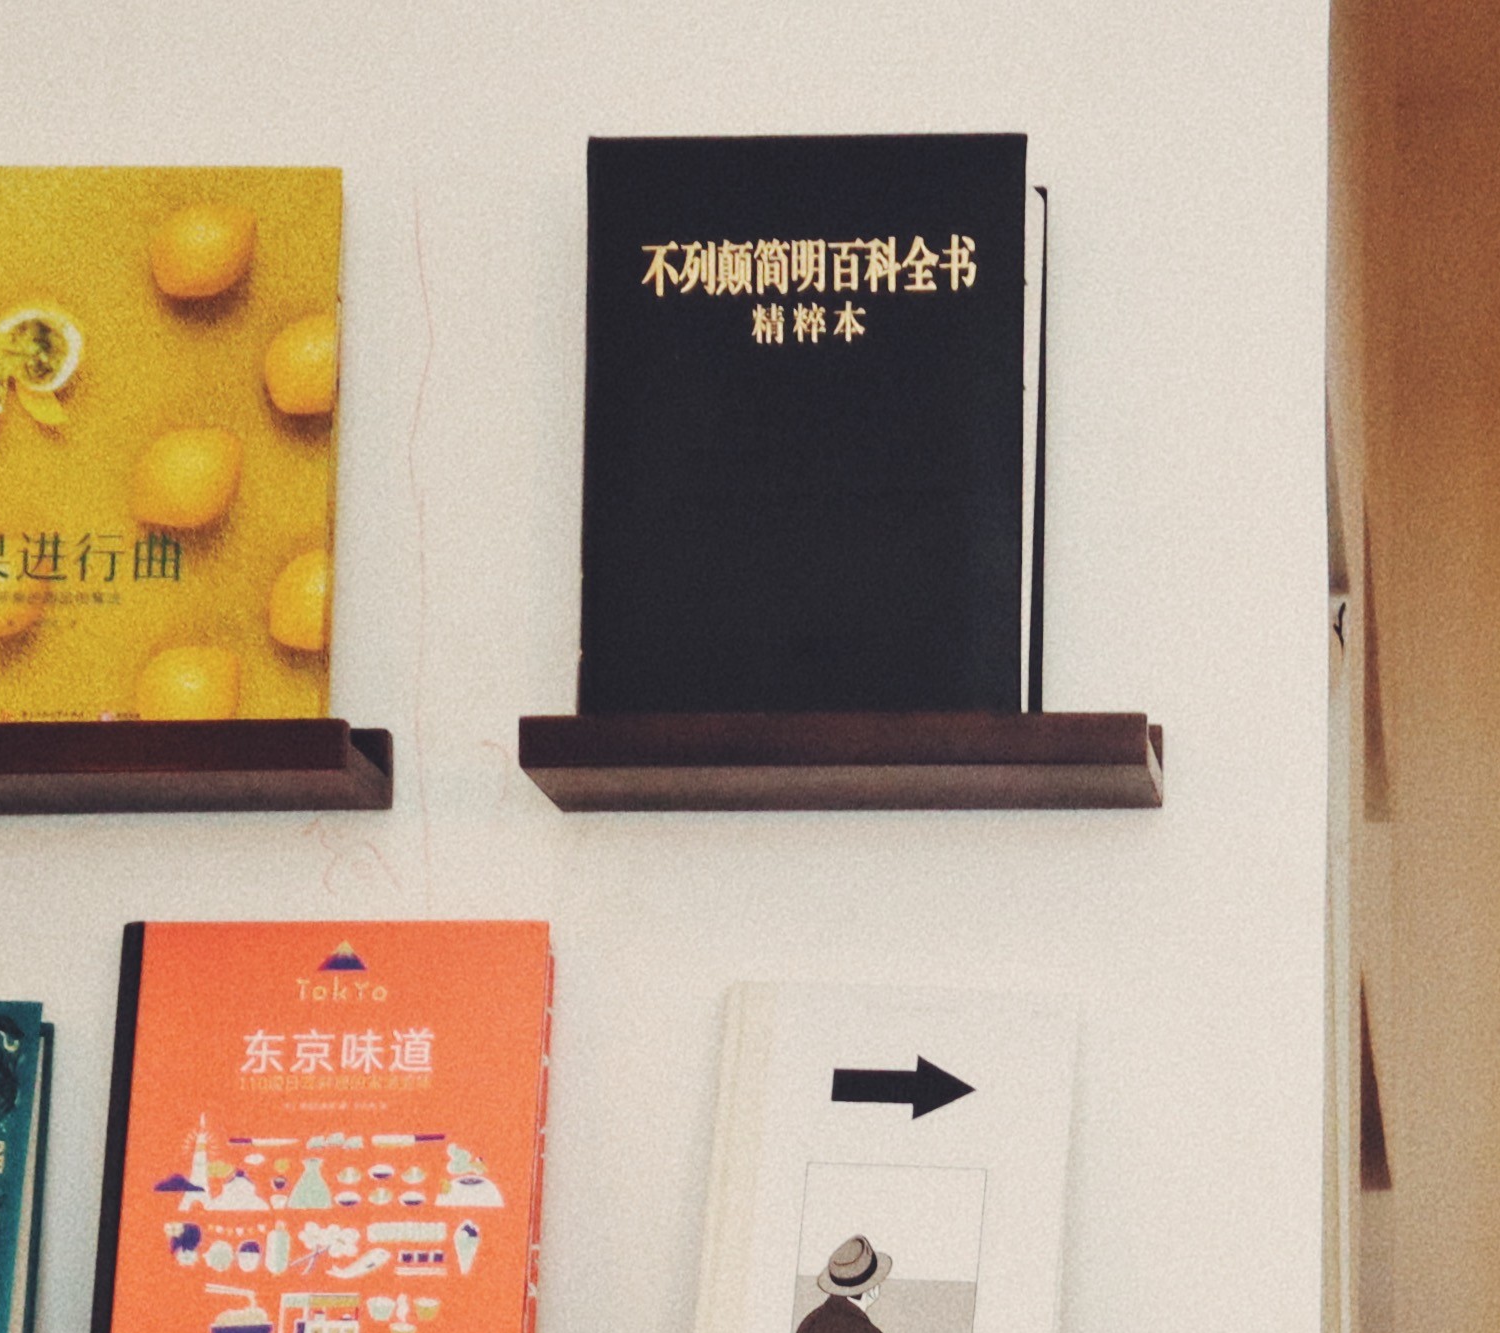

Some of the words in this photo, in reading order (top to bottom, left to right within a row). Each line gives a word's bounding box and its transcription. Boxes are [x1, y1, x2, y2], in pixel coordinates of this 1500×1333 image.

[641, 234, 978, 297] 不列颠简明百科全书
[752, 301, 867, 344] 精粹本
[240, 1028, 435, 1074] 东京味道
